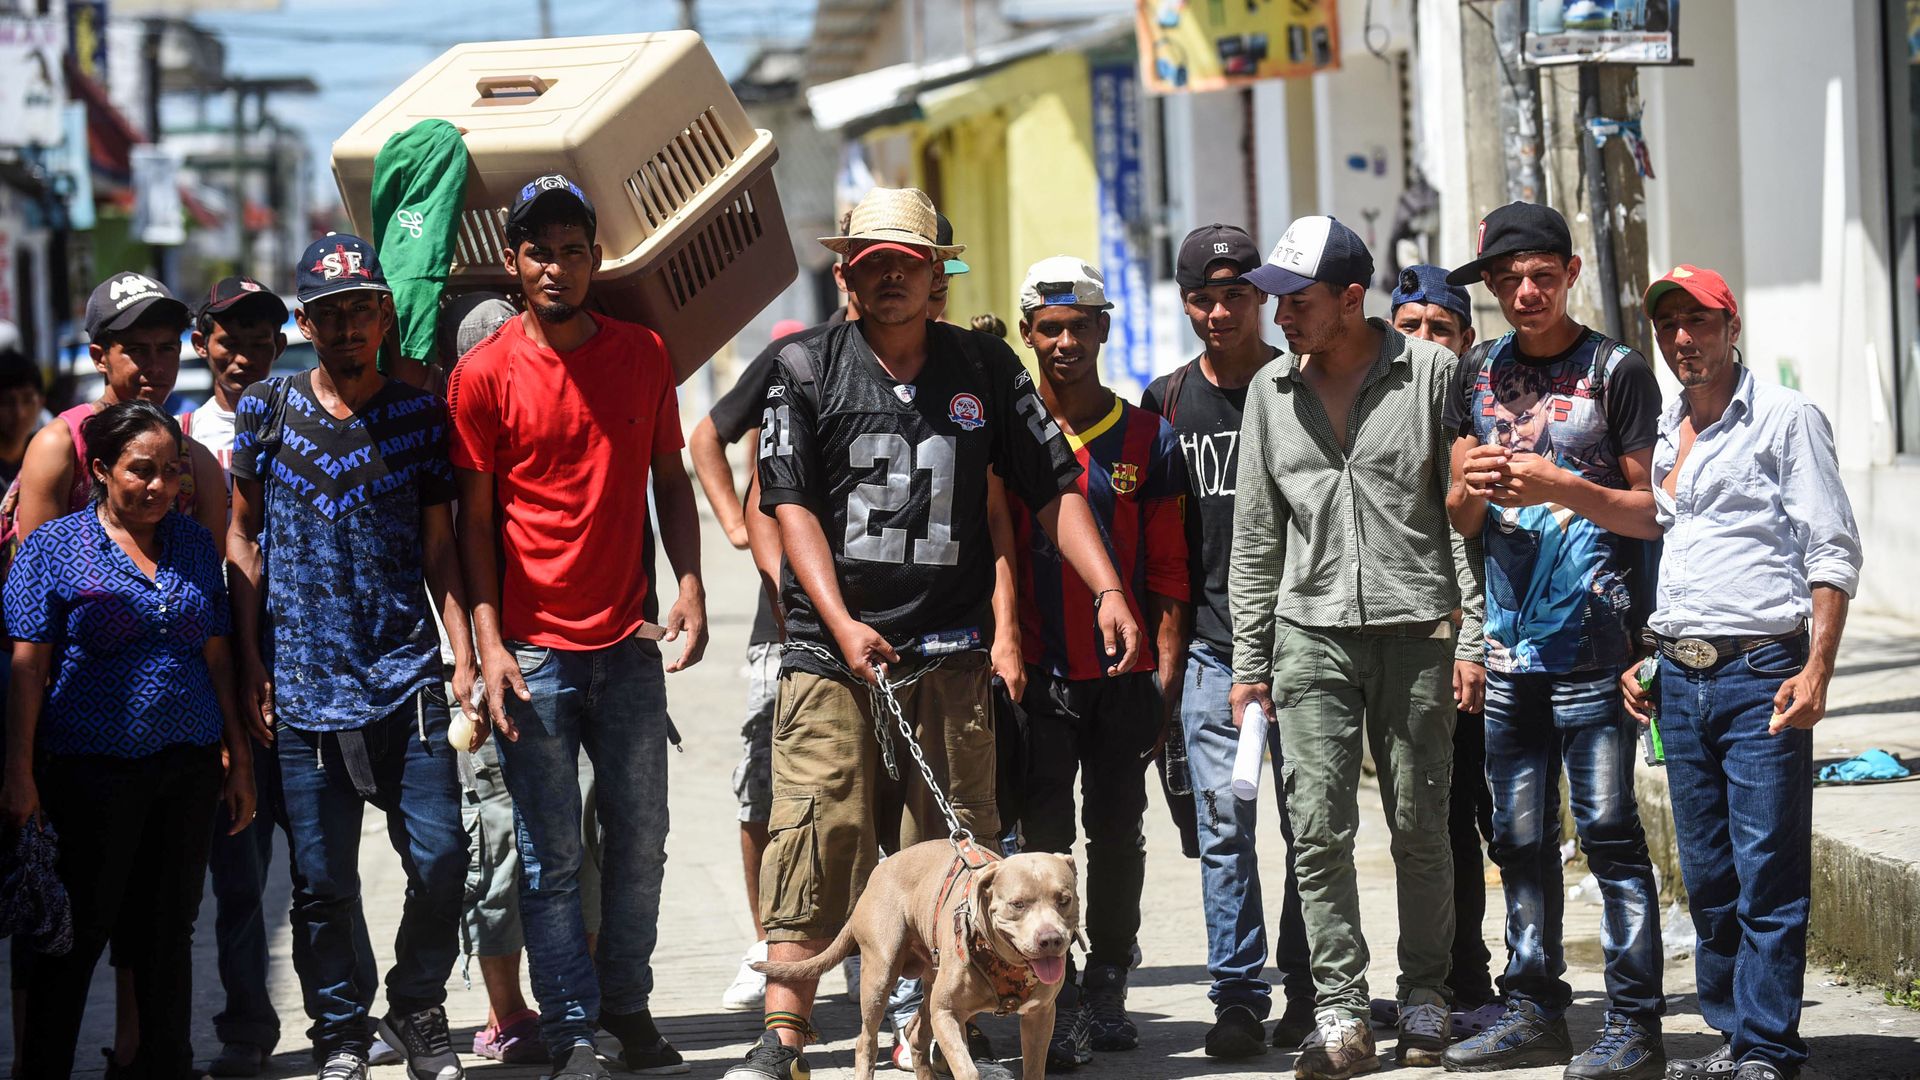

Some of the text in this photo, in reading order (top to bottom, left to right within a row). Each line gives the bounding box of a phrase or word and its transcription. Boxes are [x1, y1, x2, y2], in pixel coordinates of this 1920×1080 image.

[760, 404, 794, 460] 21
[1016, 393, 1061, 445] 2
[313, 445, 371, 480] ARMY
[379, 428, 426, 458] ARMY
[1179, 430, 1242, 498] HOZ
[312, 484, 366, 520] ARMY
[844, 433, 960, 566] 21
